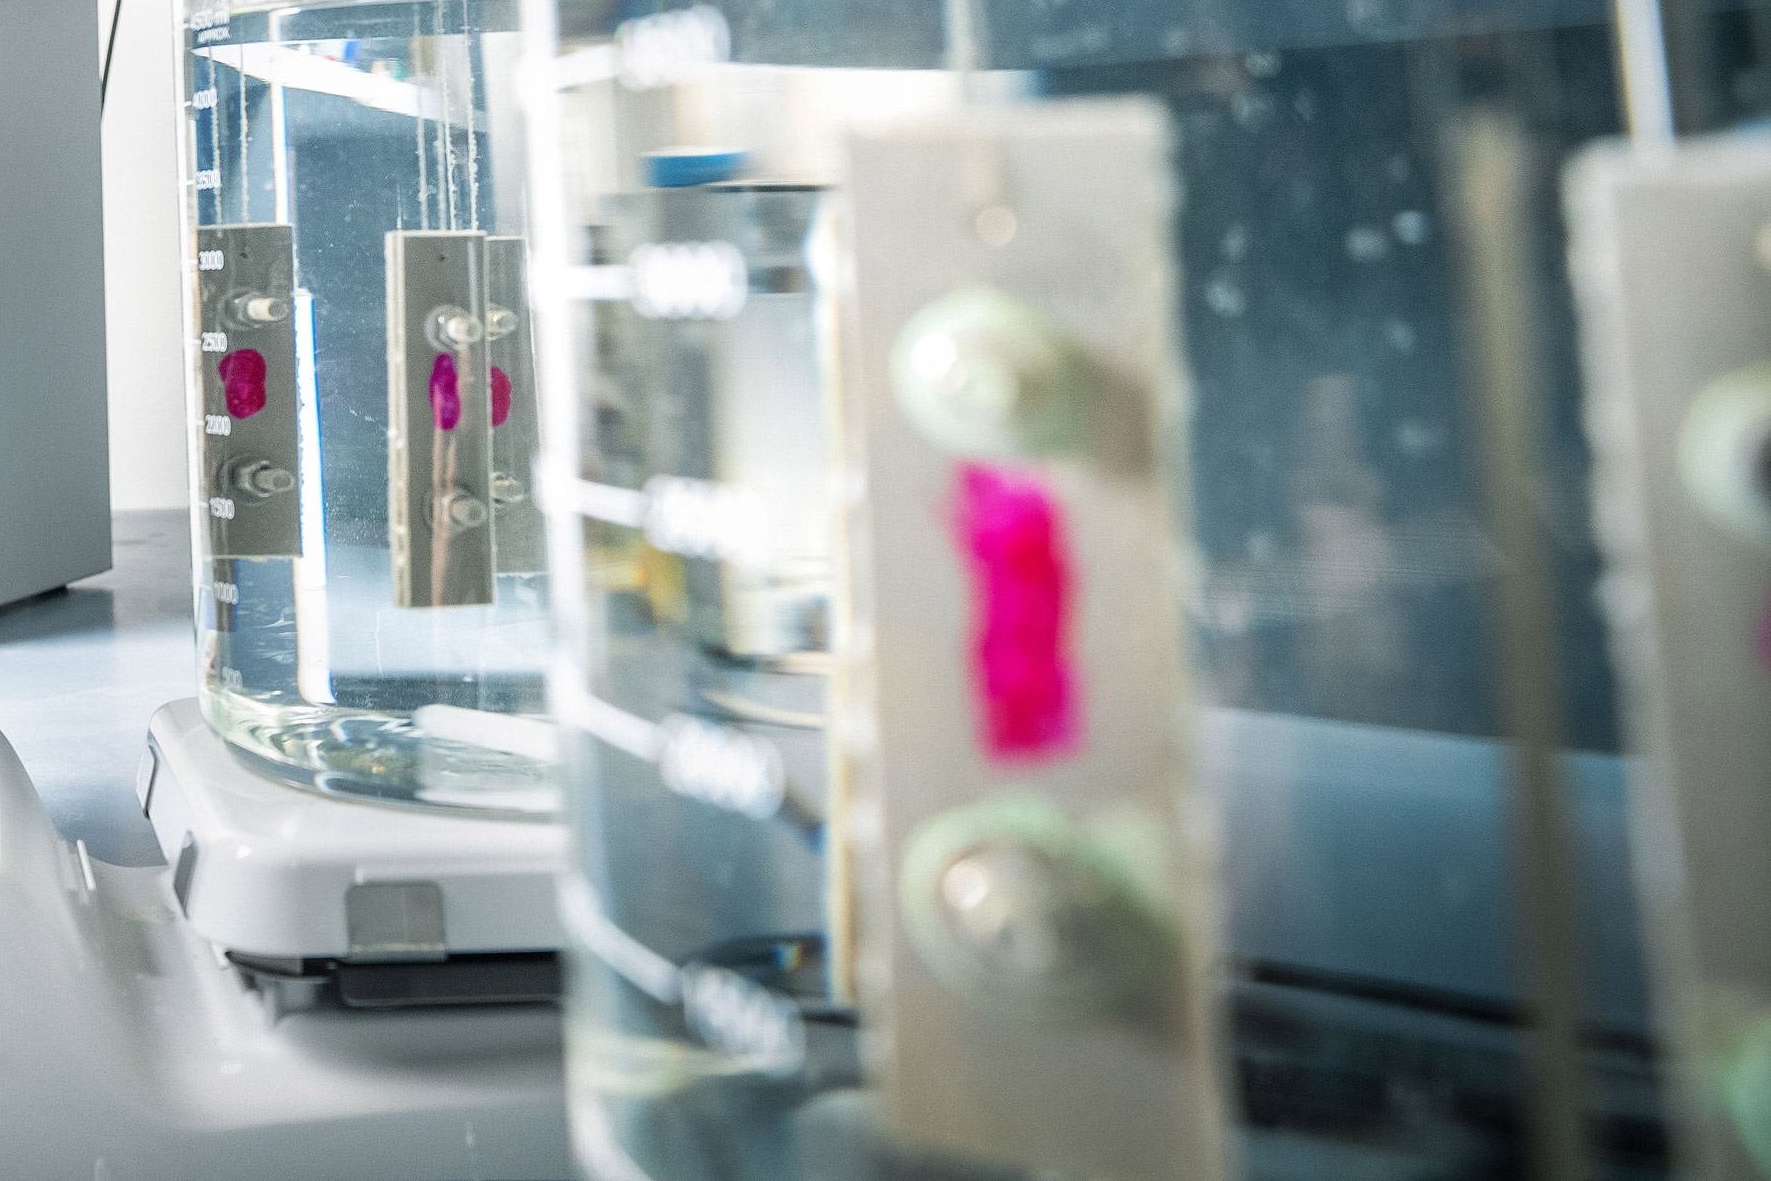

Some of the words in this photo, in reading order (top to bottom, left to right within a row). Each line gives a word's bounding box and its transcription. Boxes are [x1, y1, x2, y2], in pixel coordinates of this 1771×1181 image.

[196, 168, 221, 190] 3500
[198, 249, 224, 271] 3000
[201, 331, 228, 353] 2500
[205, 414, 231, 436] 2000
[209, 497, 235, 520] 1500
[213, 580, 239, 605] 1000
